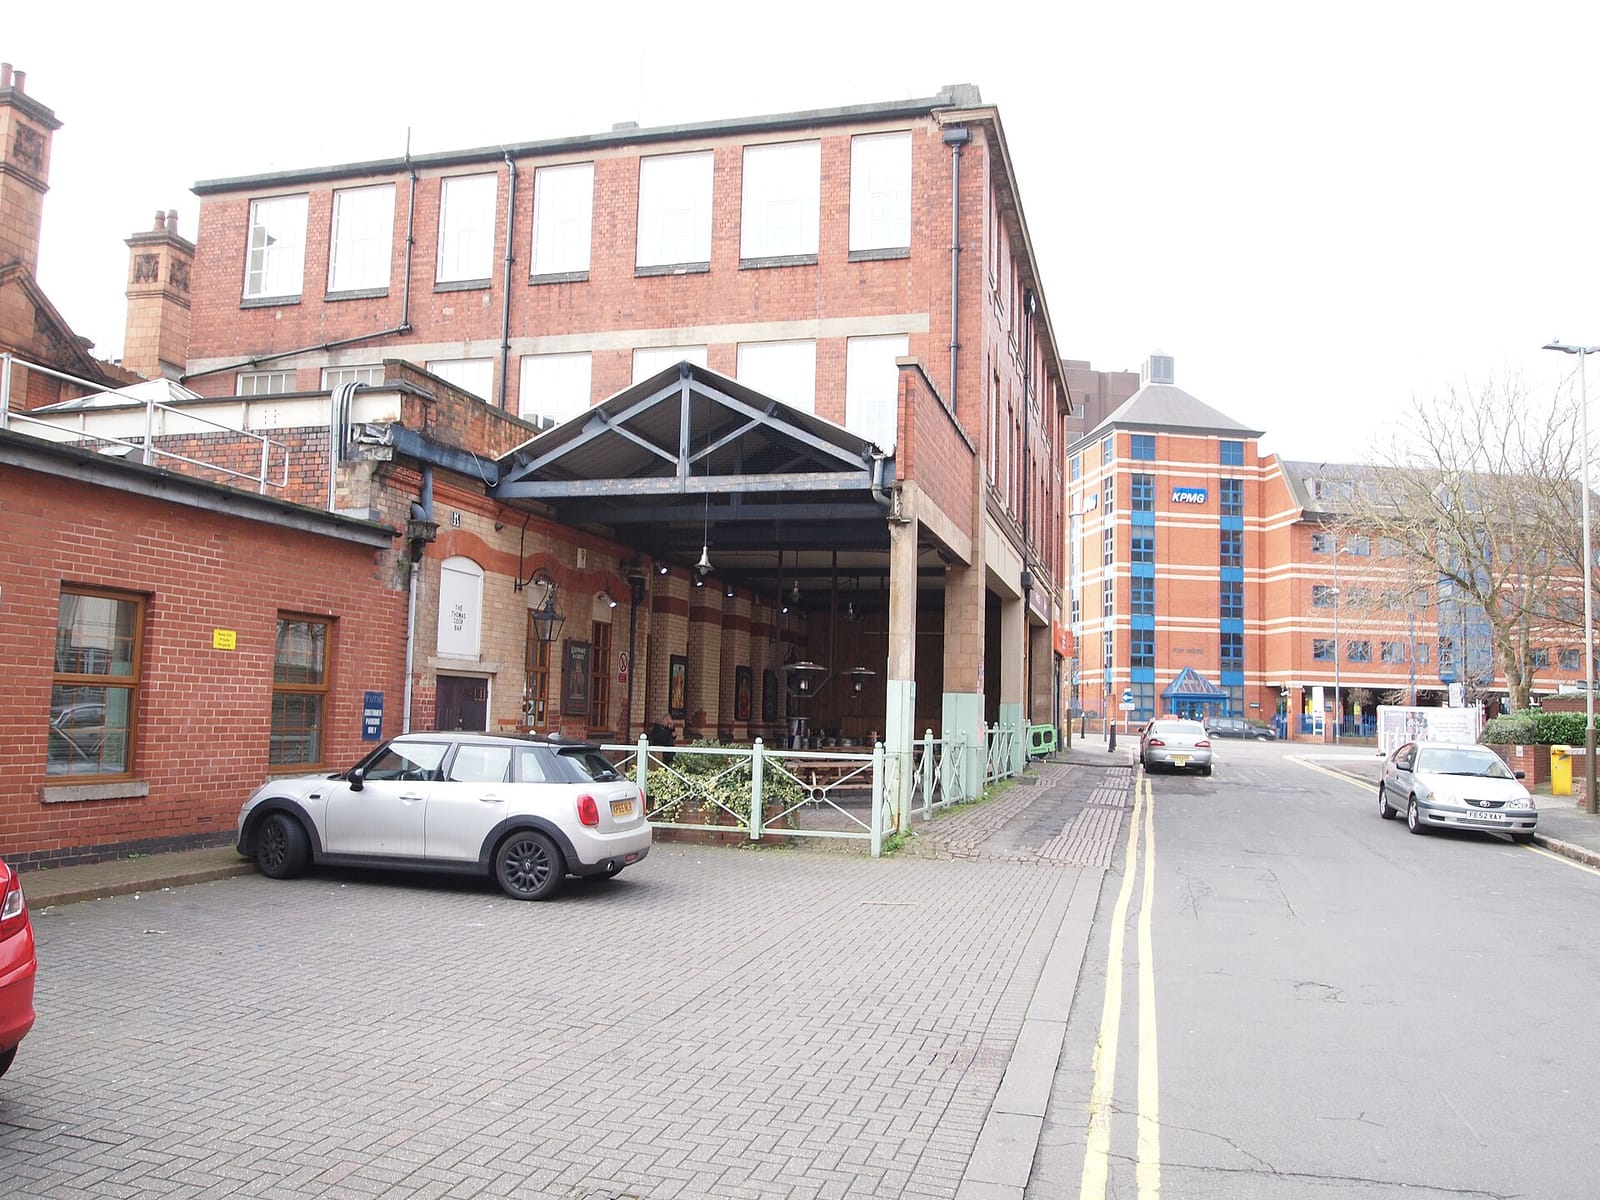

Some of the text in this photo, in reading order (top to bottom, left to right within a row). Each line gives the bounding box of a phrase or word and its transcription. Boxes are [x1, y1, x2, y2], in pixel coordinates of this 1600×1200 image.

[1172, 492, 1205, 503] KPMG
[451, 610, 466, 619] THOMAS
[364, 708, 382, 716] CUSTOMER
[365, 717, 380, 725] PARKING
[367, 726, 377, 734] ONLY
